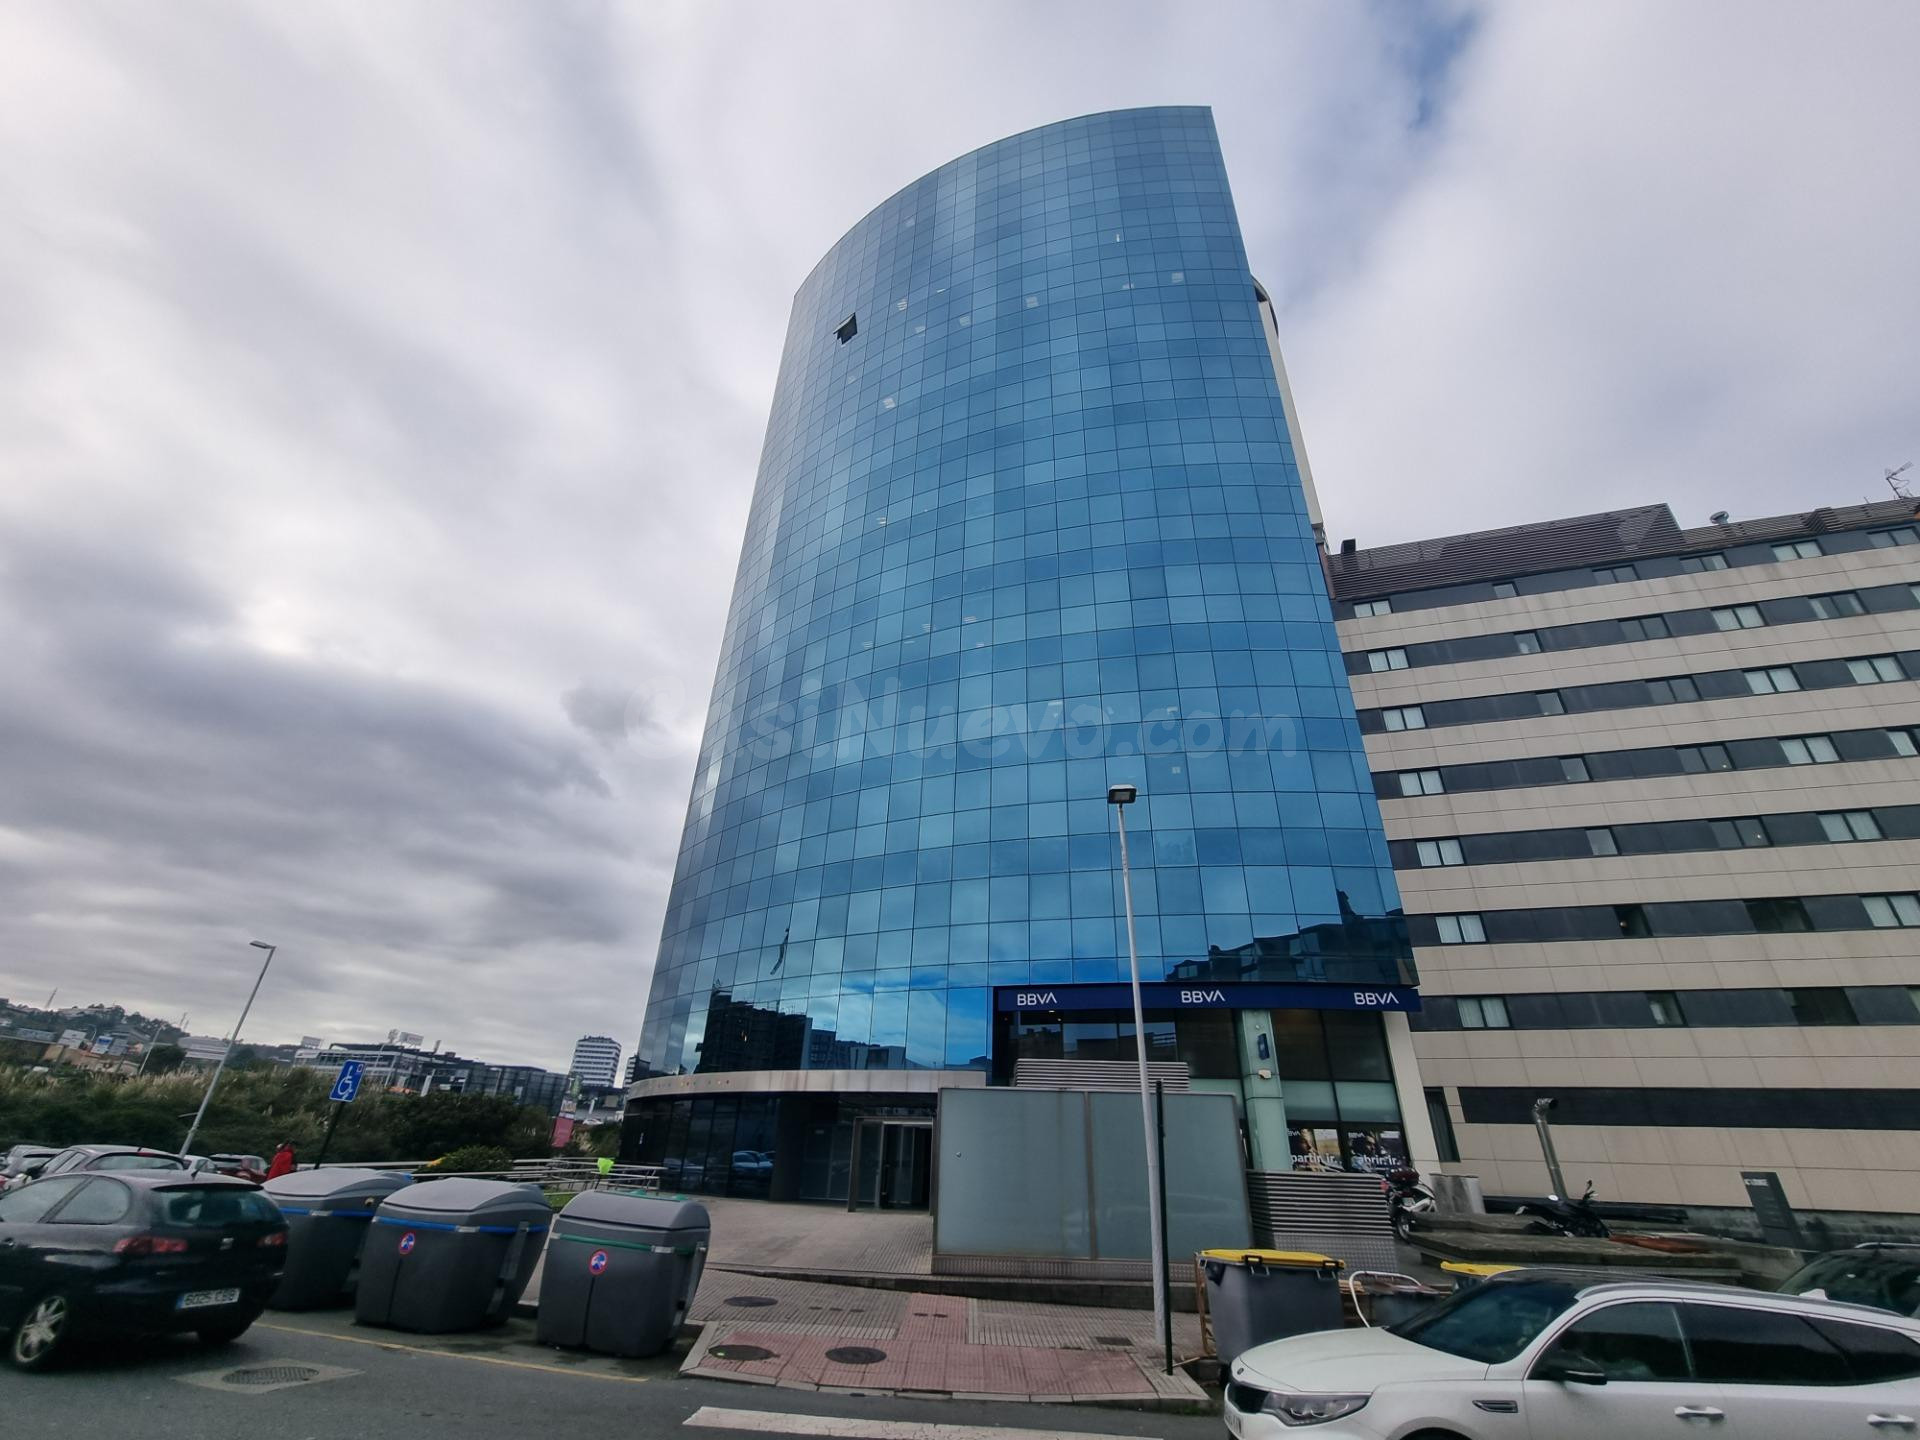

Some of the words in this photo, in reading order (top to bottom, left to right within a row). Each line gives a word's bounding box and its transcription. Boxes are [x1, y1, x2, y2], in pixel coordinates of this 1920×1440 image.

[1017, 991, 1058, 1006] BBVA
[1181, 989, 1226, 1003] BBVA
[1353, 991, 1400, 1005] BBVA
